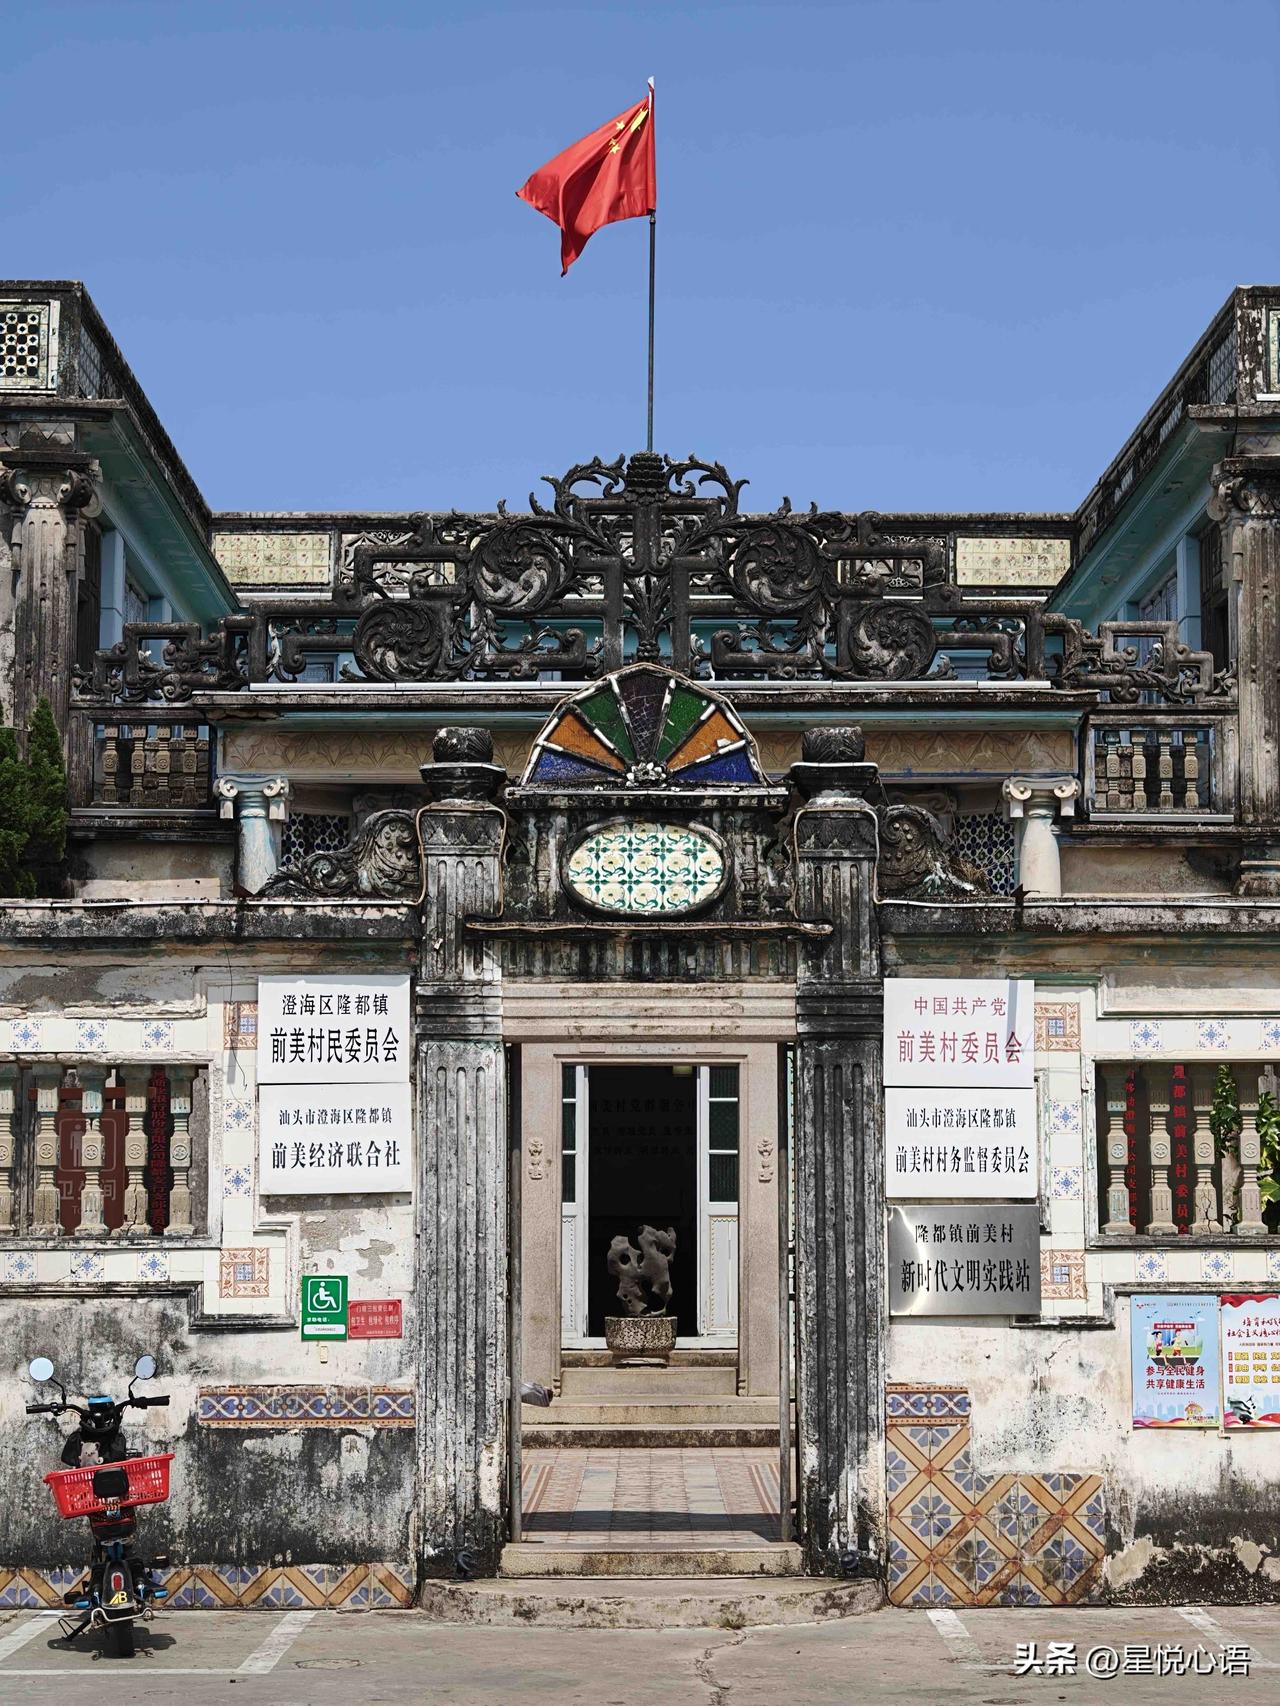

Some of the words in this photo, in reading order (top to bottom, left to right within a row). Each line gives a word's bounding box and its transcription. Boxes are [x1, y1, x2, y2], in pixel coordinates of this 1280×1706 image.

[282, 993, 389, 1016] 澄海区隆都镇
[914, 996, 1007, 1016] 中国共产党
[270, 1027, 399, 1064] 前美村民委员会
[897, 1030, 1022, 1064] 前美村委员会
[279, 1107, 393, 1126] 汕头市澄海区隆都镇
[906, 1107, 1017, 1129] 汕头市澄海区隆都镇
[272, 1140, 401, 1169] 前美经济联合社
[895, 1145, 1030, 1174] 前美村村务监督委员会
[915, 1223, 1014, 1244] 隆都镇前美村
[900, 1258, 1031, 1293] 新时代文明实践站
[1145, 1365, 1205, 1376] 参与全民健身
[1145, 1379, 1206, 1390] 共享健康生活
